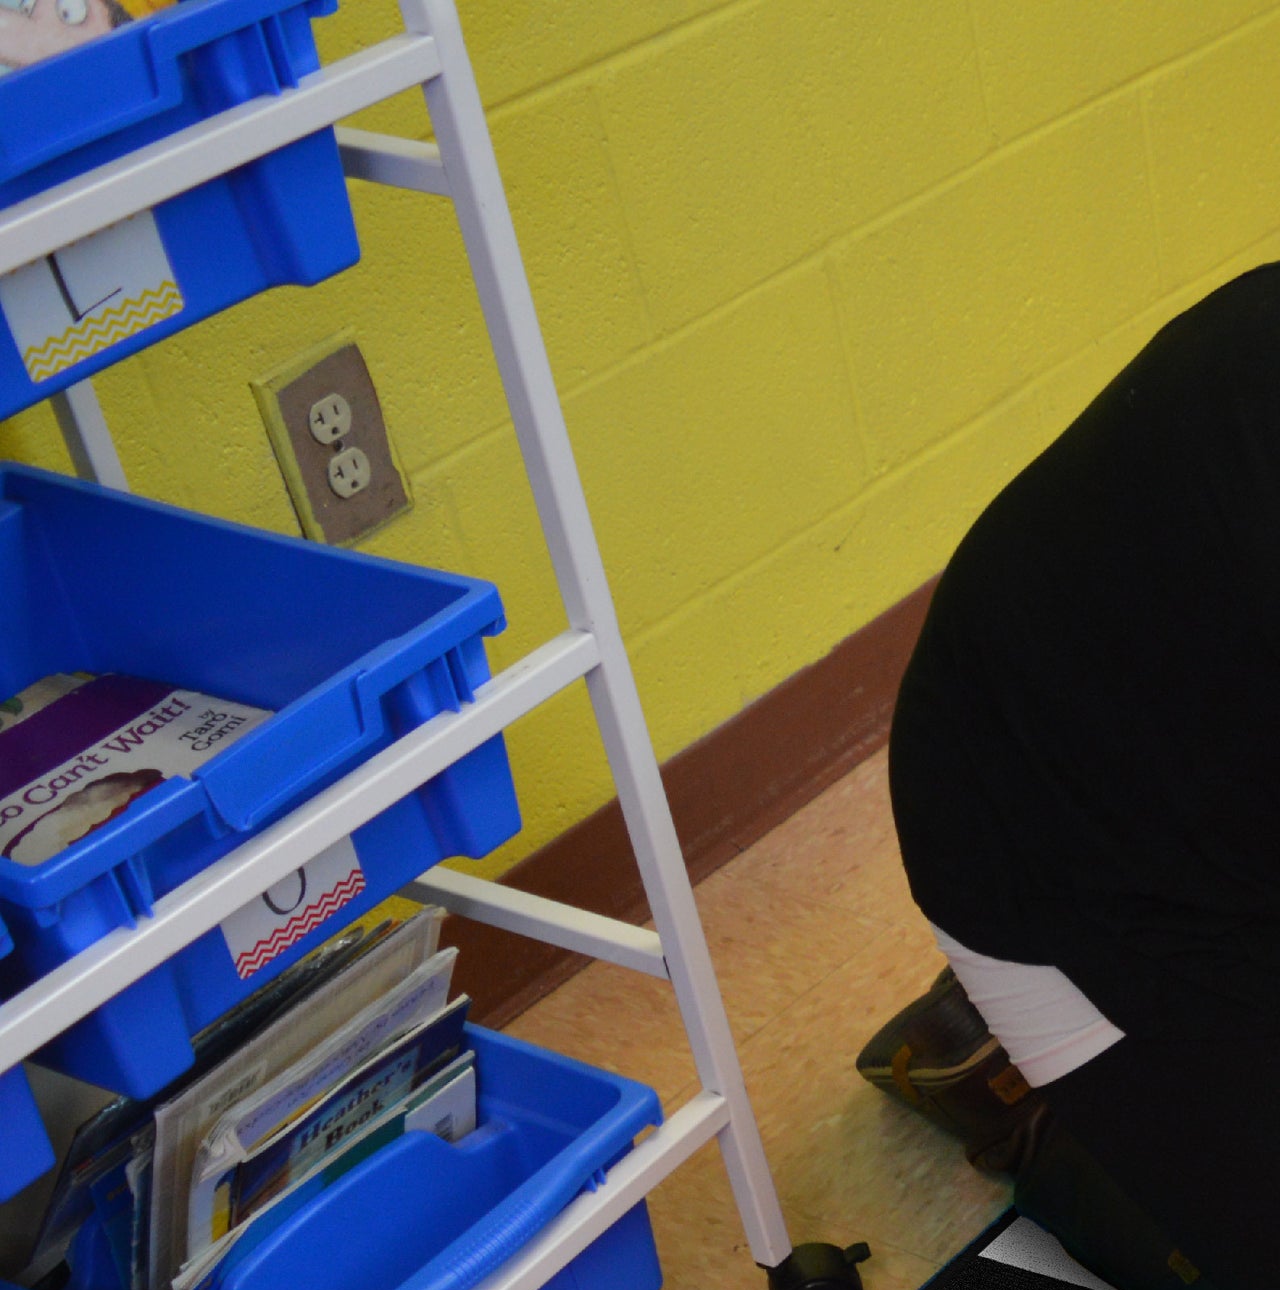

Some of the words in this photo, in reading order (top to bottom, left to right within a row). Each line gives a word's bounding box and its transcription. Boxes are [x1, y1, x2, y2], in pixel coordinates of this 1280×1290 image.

[179, 712, 228, 744] Taro
[191, 715, 249, 752] Gomi
[23, 753, 108, 805] Can't
[103, 697, 192, 754] Wait!
